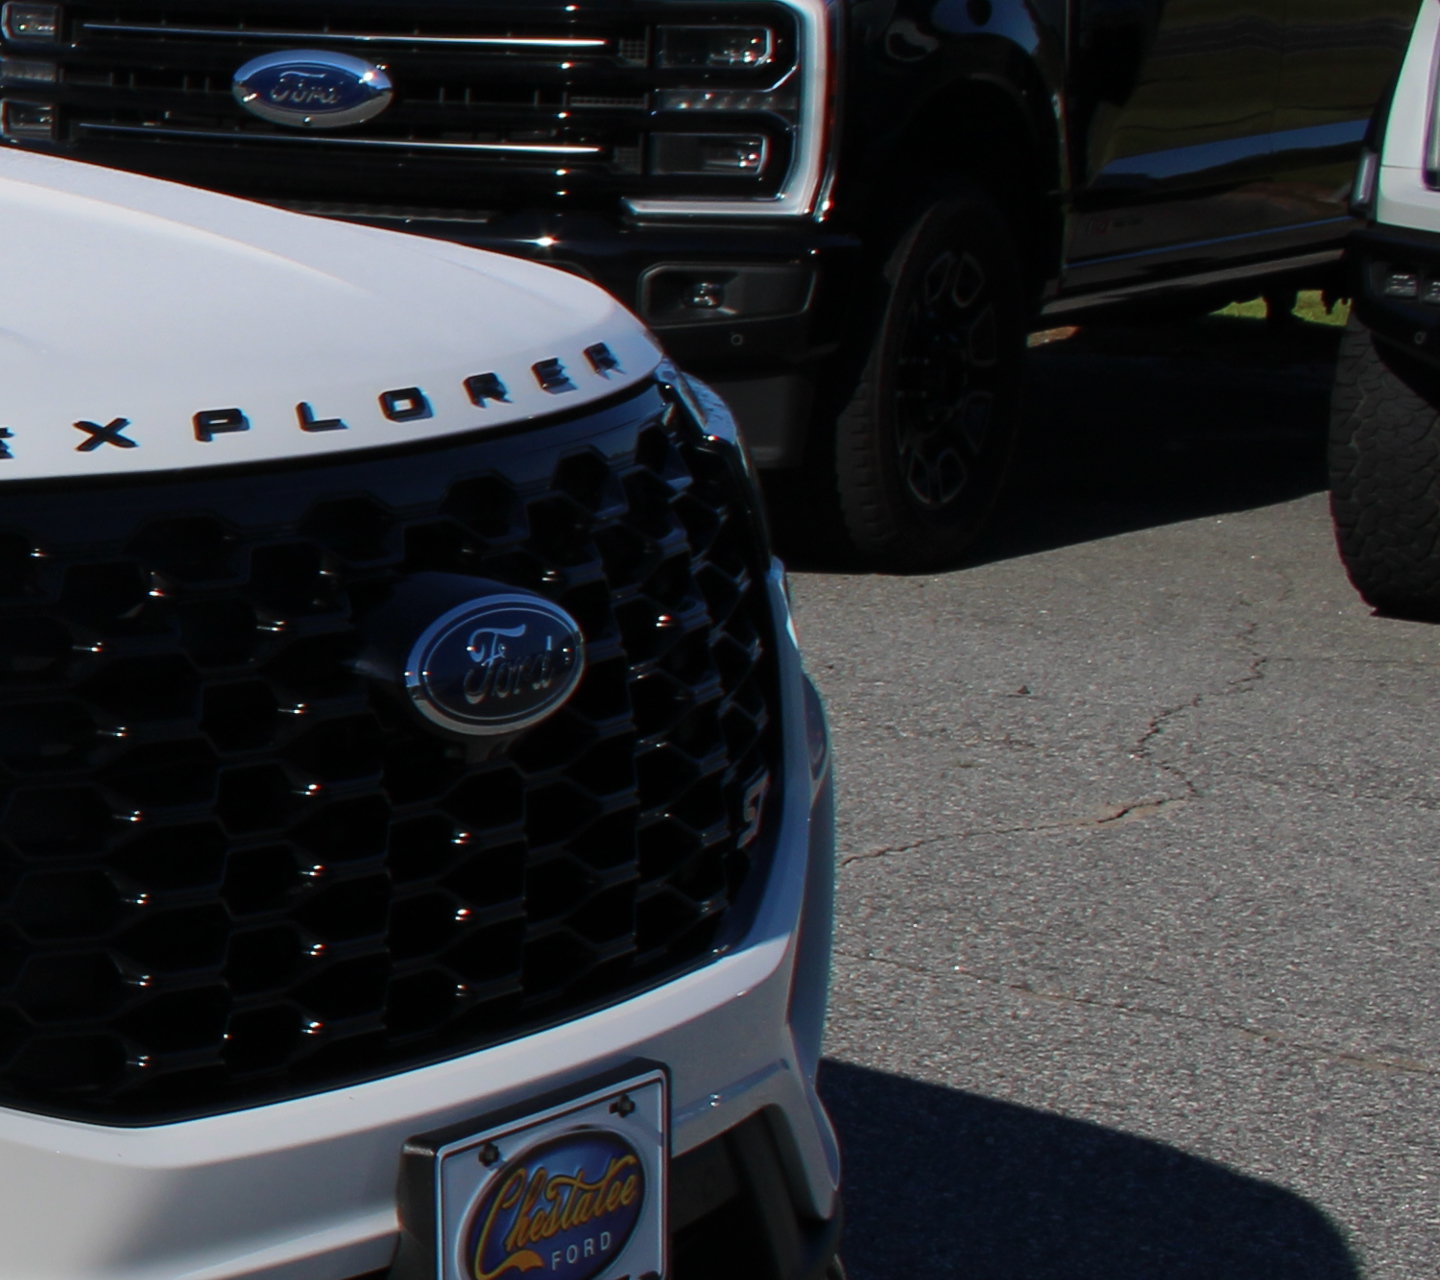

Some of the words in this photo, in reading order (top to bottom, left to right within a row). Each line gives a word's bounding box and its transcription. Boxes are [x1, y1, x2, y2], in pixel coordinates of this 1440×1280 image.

[269, 70, 342, 105] Ford
[463, 623, 555, 705] Ford
[550, 1230, 613, 1271] FORD
